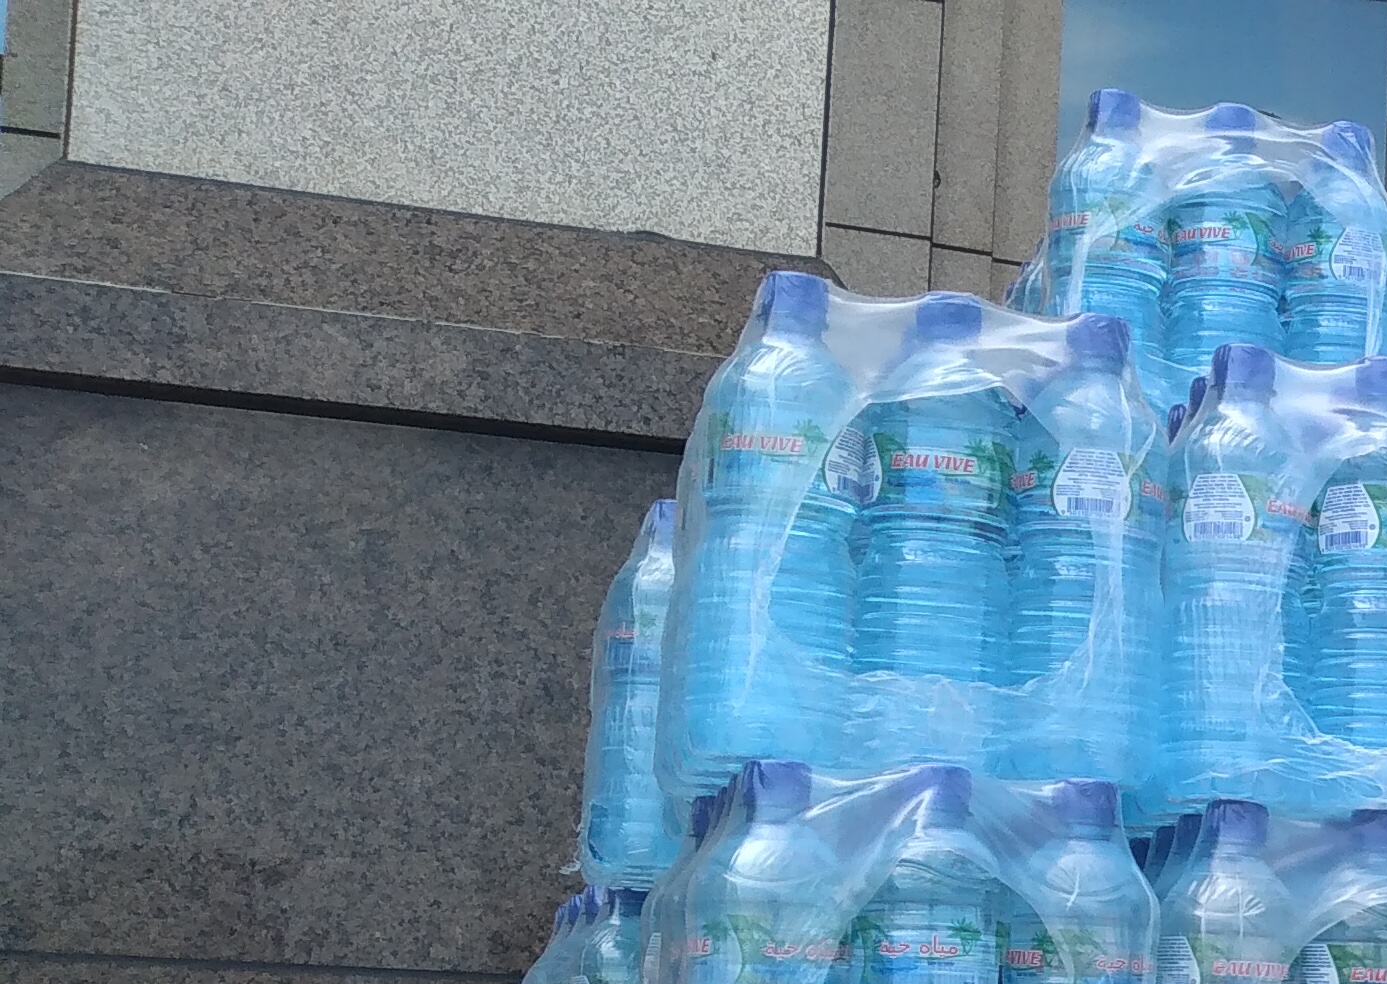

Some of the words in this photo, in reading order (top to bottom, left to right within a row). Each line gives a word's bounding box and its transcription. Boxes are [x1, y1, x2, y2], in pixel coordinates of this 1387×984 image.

[1202, 227, 1230, 239] VIVE
[721, 434, 754, 449] EAU
[759, 435, 803, 453] VIVE
[892, 454, 928, 469] EAU
[934, 455, 975, 472] VIVE
[879, 942, 910, 956] حية
[919, 936, 959, 956] مياه
[1212, 961, 1252, 977] EAU
[1351, 967, 1387, 984] EAU
